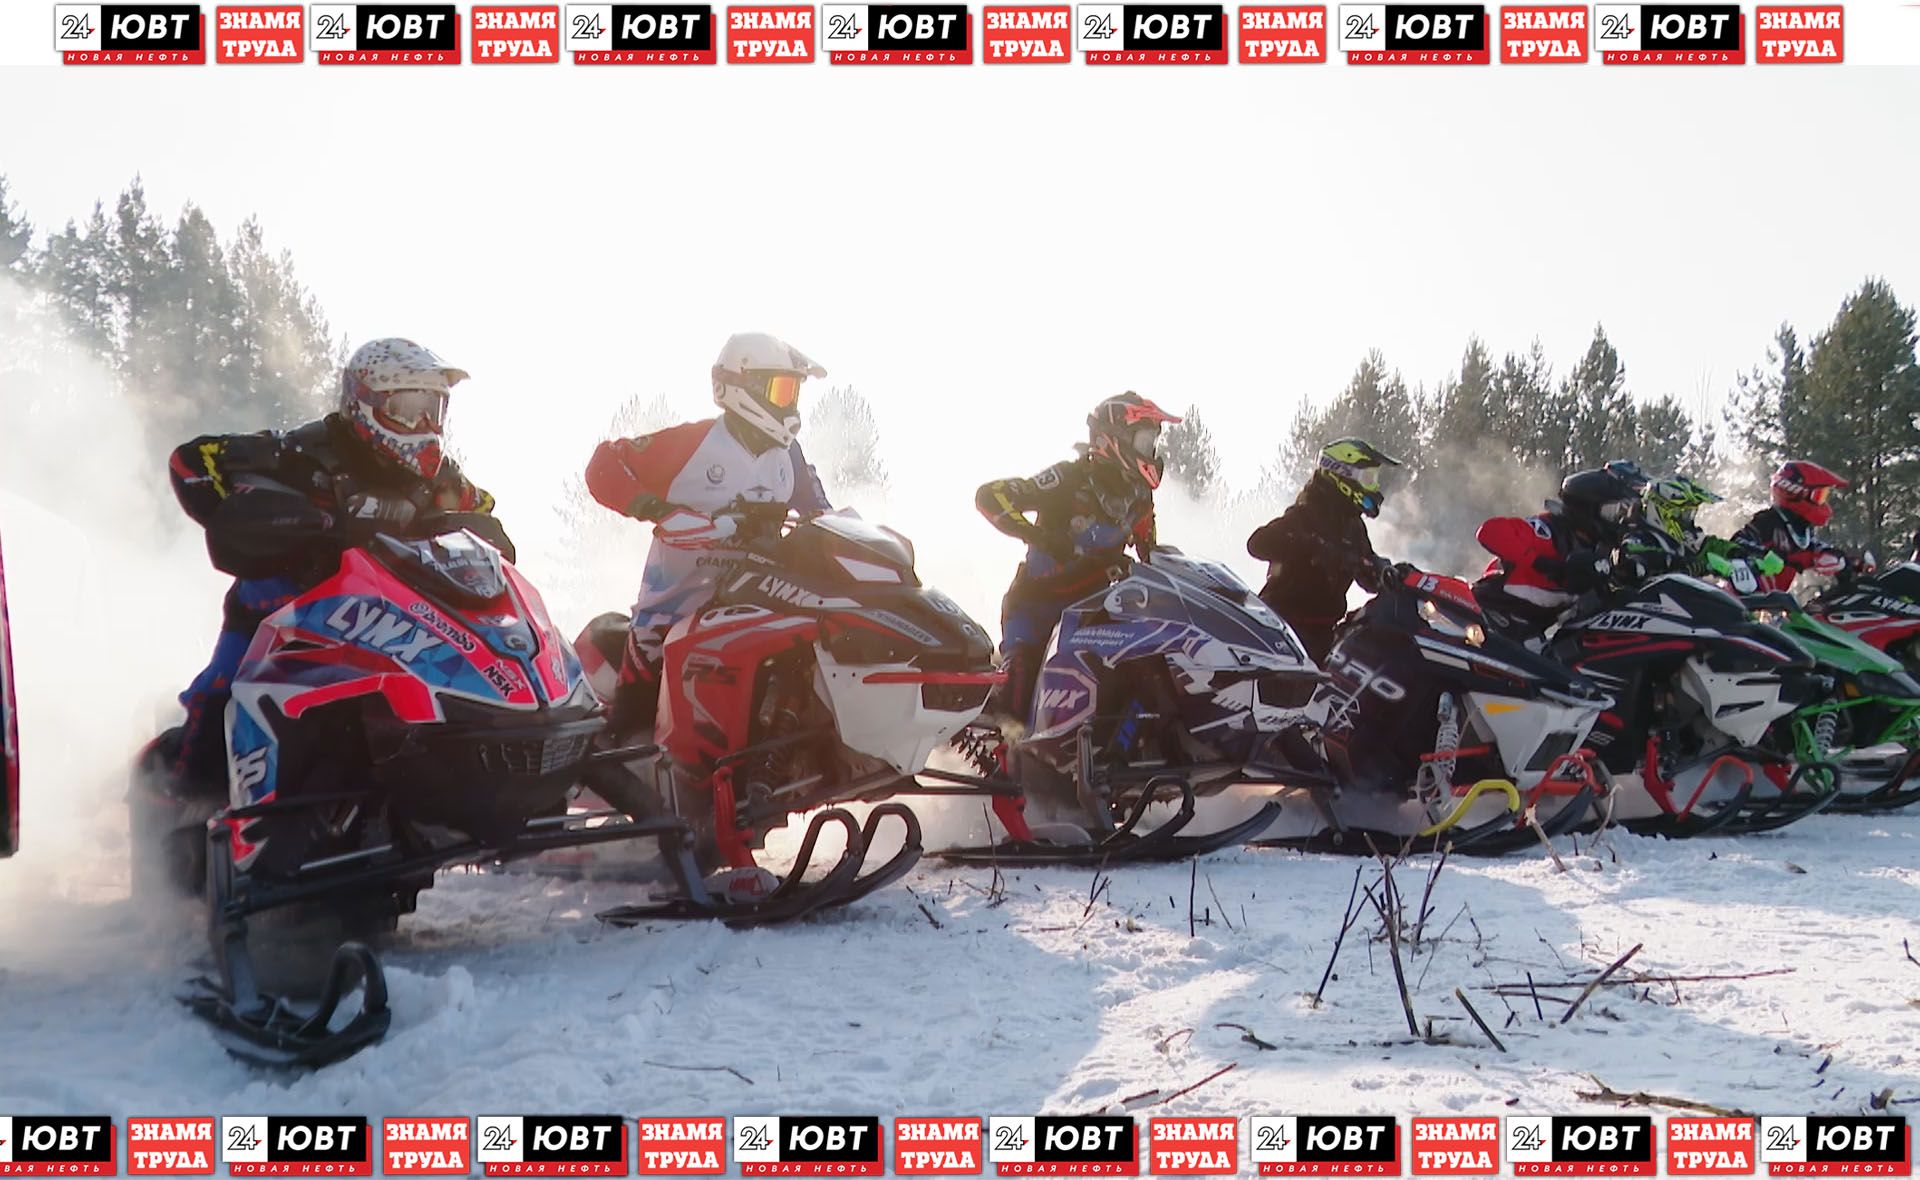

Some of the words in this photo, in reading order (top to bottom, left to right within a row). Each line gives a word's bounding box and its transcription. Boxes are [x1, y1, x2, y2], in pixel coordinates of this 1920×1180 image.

[758, 575, 818, 608] LYNX
[326, 597, 444, 663] LYNX
[1598, 614, 1652, 630] LYNX
[484, 665, 516, 697] NSK
[1038, 689, 1088, 710] YNX
